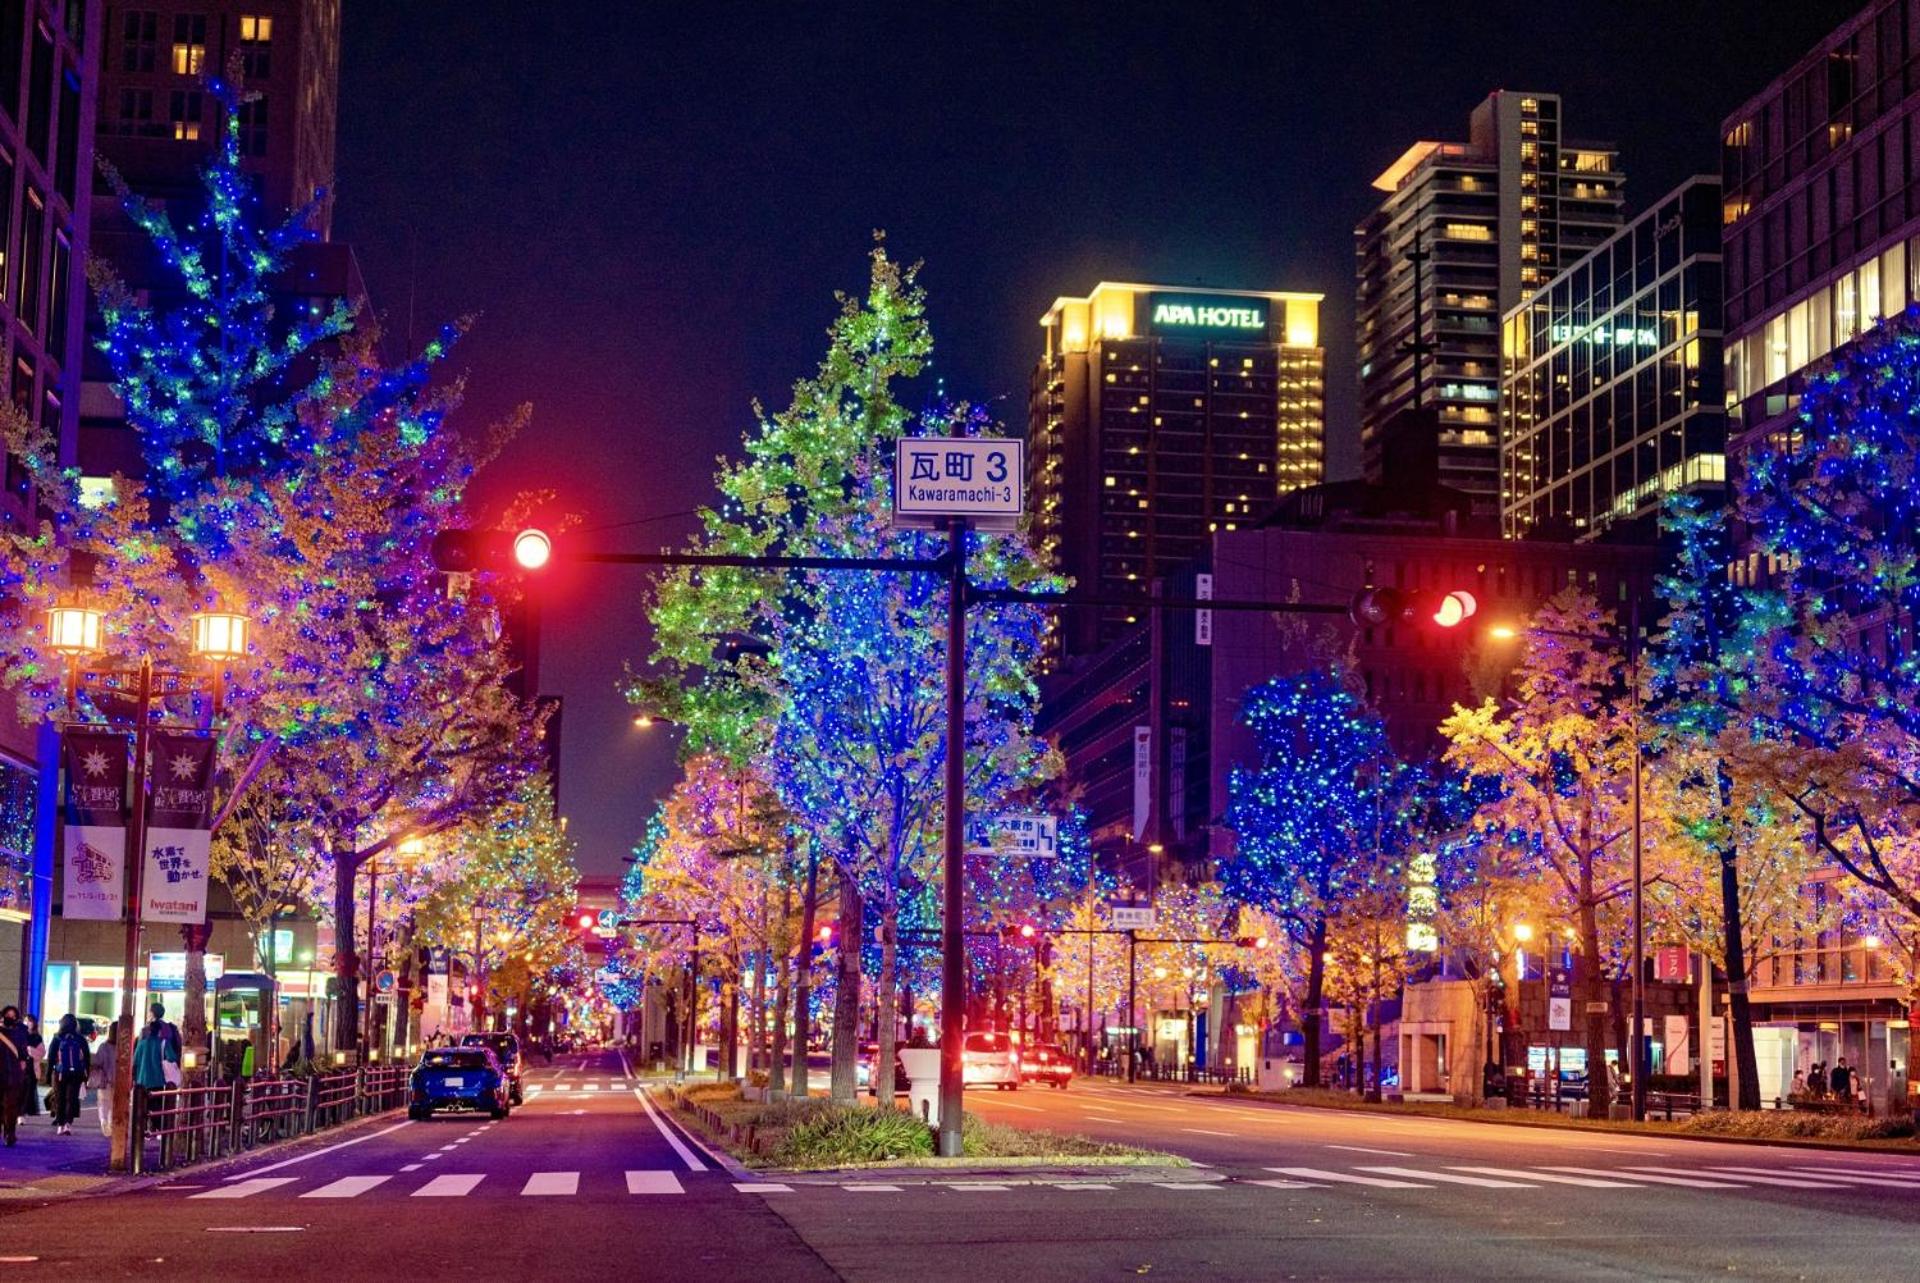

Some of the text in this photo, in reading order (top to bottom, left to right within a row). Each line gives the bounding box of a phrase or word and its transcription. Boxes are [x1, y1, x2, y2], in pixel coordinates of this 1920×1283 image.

[1153, 304, 1265, 329] APA HOTEL
[910, 451, 1008, 483] 瓦町 3
[909, 486, 1011, 503] Kawaramachi-3
[159, 857, 191, 870] 世界を
